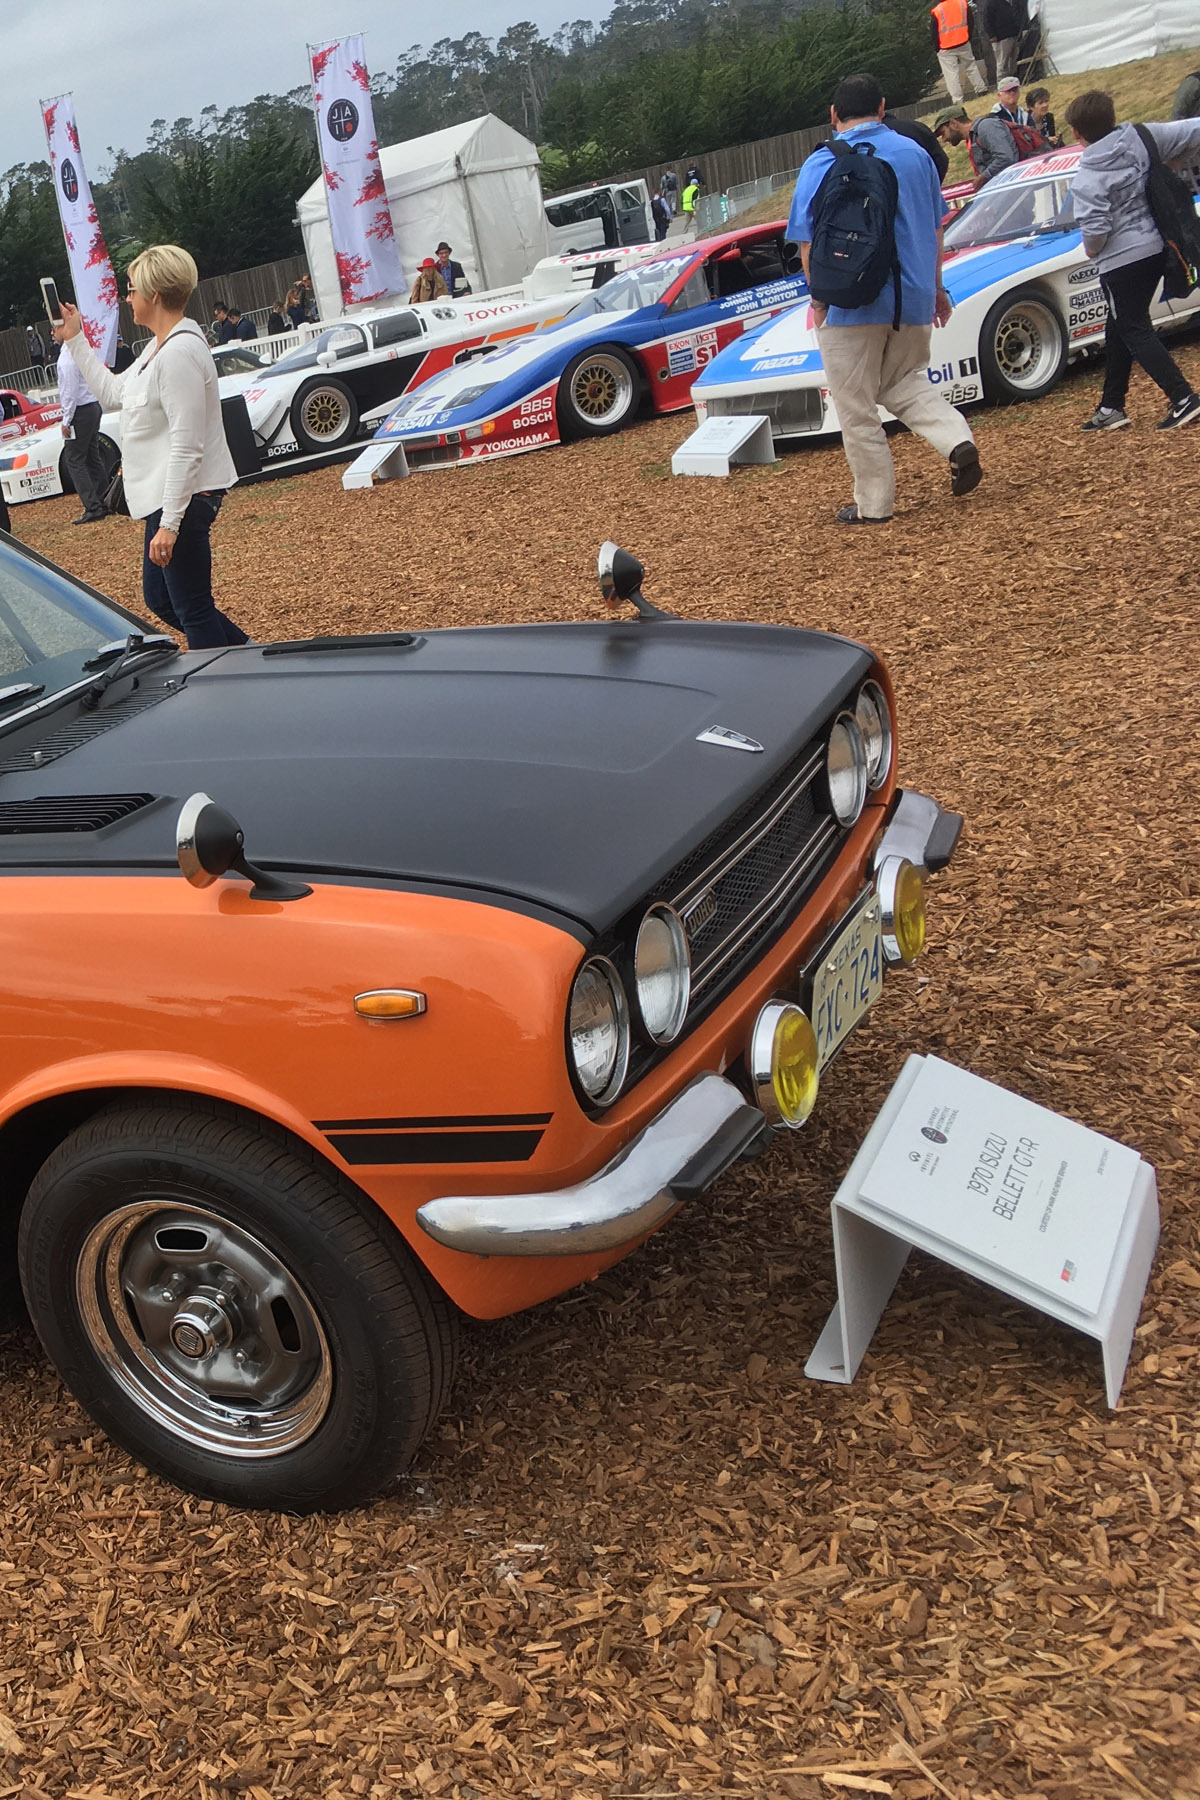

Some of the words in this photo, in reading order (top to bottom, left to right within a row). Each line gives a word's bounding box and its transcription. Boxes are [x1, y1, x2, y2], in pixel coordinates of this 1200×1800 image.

[719, 294, 753, 309] JOHNNY
[756, 280, 805, 298] O'CONNELL
[725, 290, 754, 301] STEVE
[756, 280, 788, 292] MILLEN
[464, 301, 530, 322] TOYOTA
[736, 301, 759, 314] JOHN
[761, 289, 798, 307] MORTON
[1069, 304, 1110, 327] BOSCH
[669, 339, 690, 351] EXXON
[697, 344, 717, 365] S1
[927, 362, 954, 384] bil
[40, 408, 65, 422] maz
[520, 396, 552, 415] BBS
[24, 423, 39, 435] SSC
[390, 413, 437, 432] NISSAN
[512, 411, 553, 429] BOSCH
[267, 442, 299, 458] BOSCH
[486, 432, 551, 453] YOKOHAMA
[688, 895, 714, 933] DOHC
[834, 924, 862, 972] TEXAS
[817, 978, 843, 1049] FXC
[850, 934, 880, 1011] 724
[978, 1131, 1007, 1170] ISUZU
[966, 1166, 995, 1196] 1970
[992, 1163, 1029, 1221] BELLETT
[1012, 1136, 1040, 1168] GT-R
[33, 1214, 58, 1311] DEFENDER
